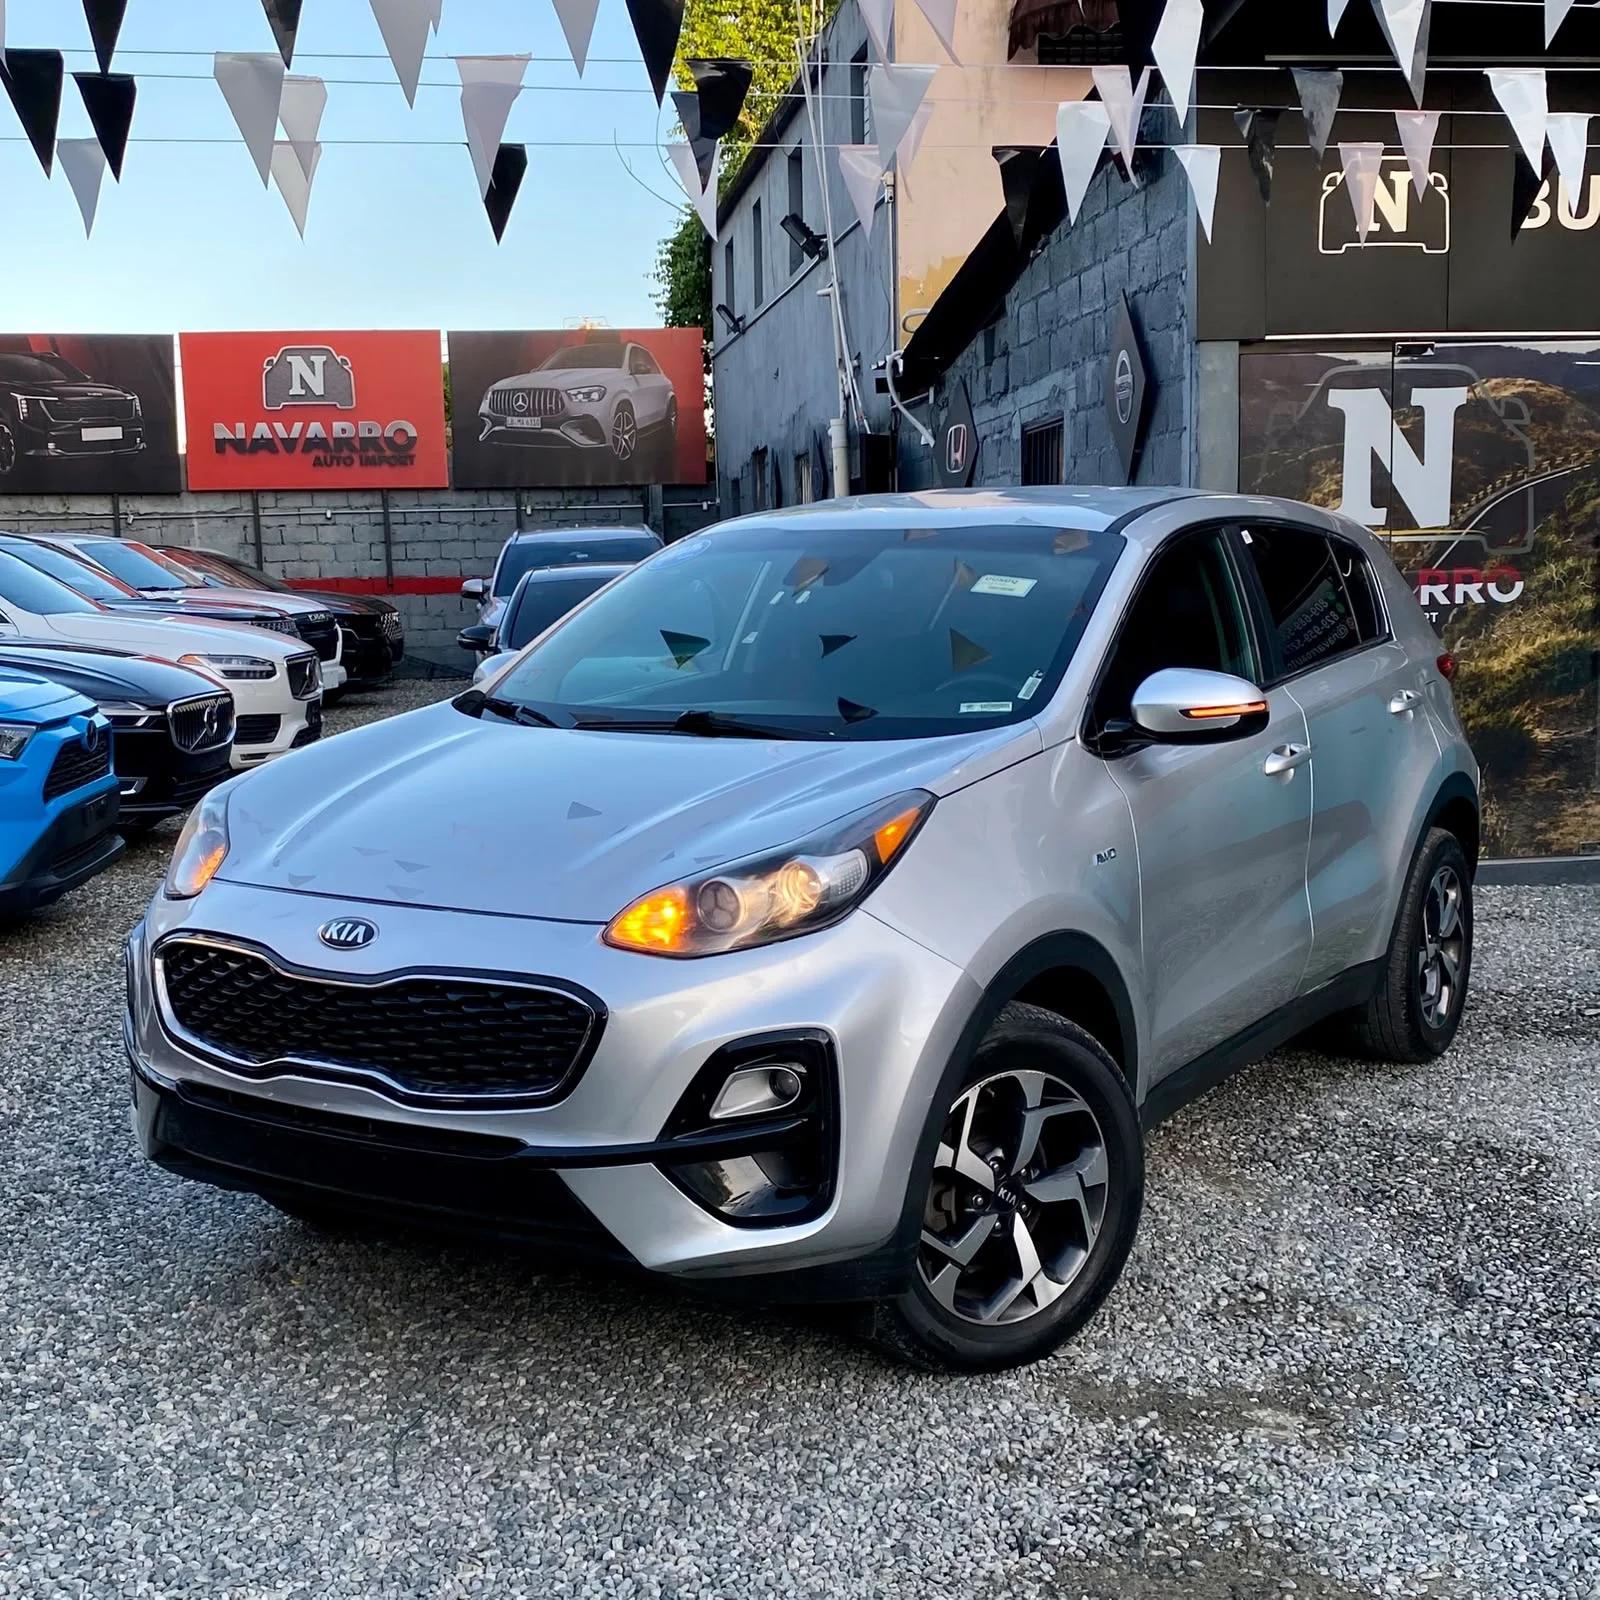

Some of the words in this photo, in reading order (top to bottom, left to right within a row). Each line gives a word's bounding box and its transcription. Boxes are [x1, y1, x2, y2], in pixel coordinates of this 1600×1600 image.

[1355, 171, 1414, 233] N
[286, 355, 327, 396] N
[213, 420, 418, 454] NAVARRO
[312, 455, 355, 468] AUTO
[359, 453, 416, 467] IMPORT
[1327, 386, 1469, 529] N
[325, 921, 367, 944] KIA
[997, 1187, 1017, 1206] KIA
